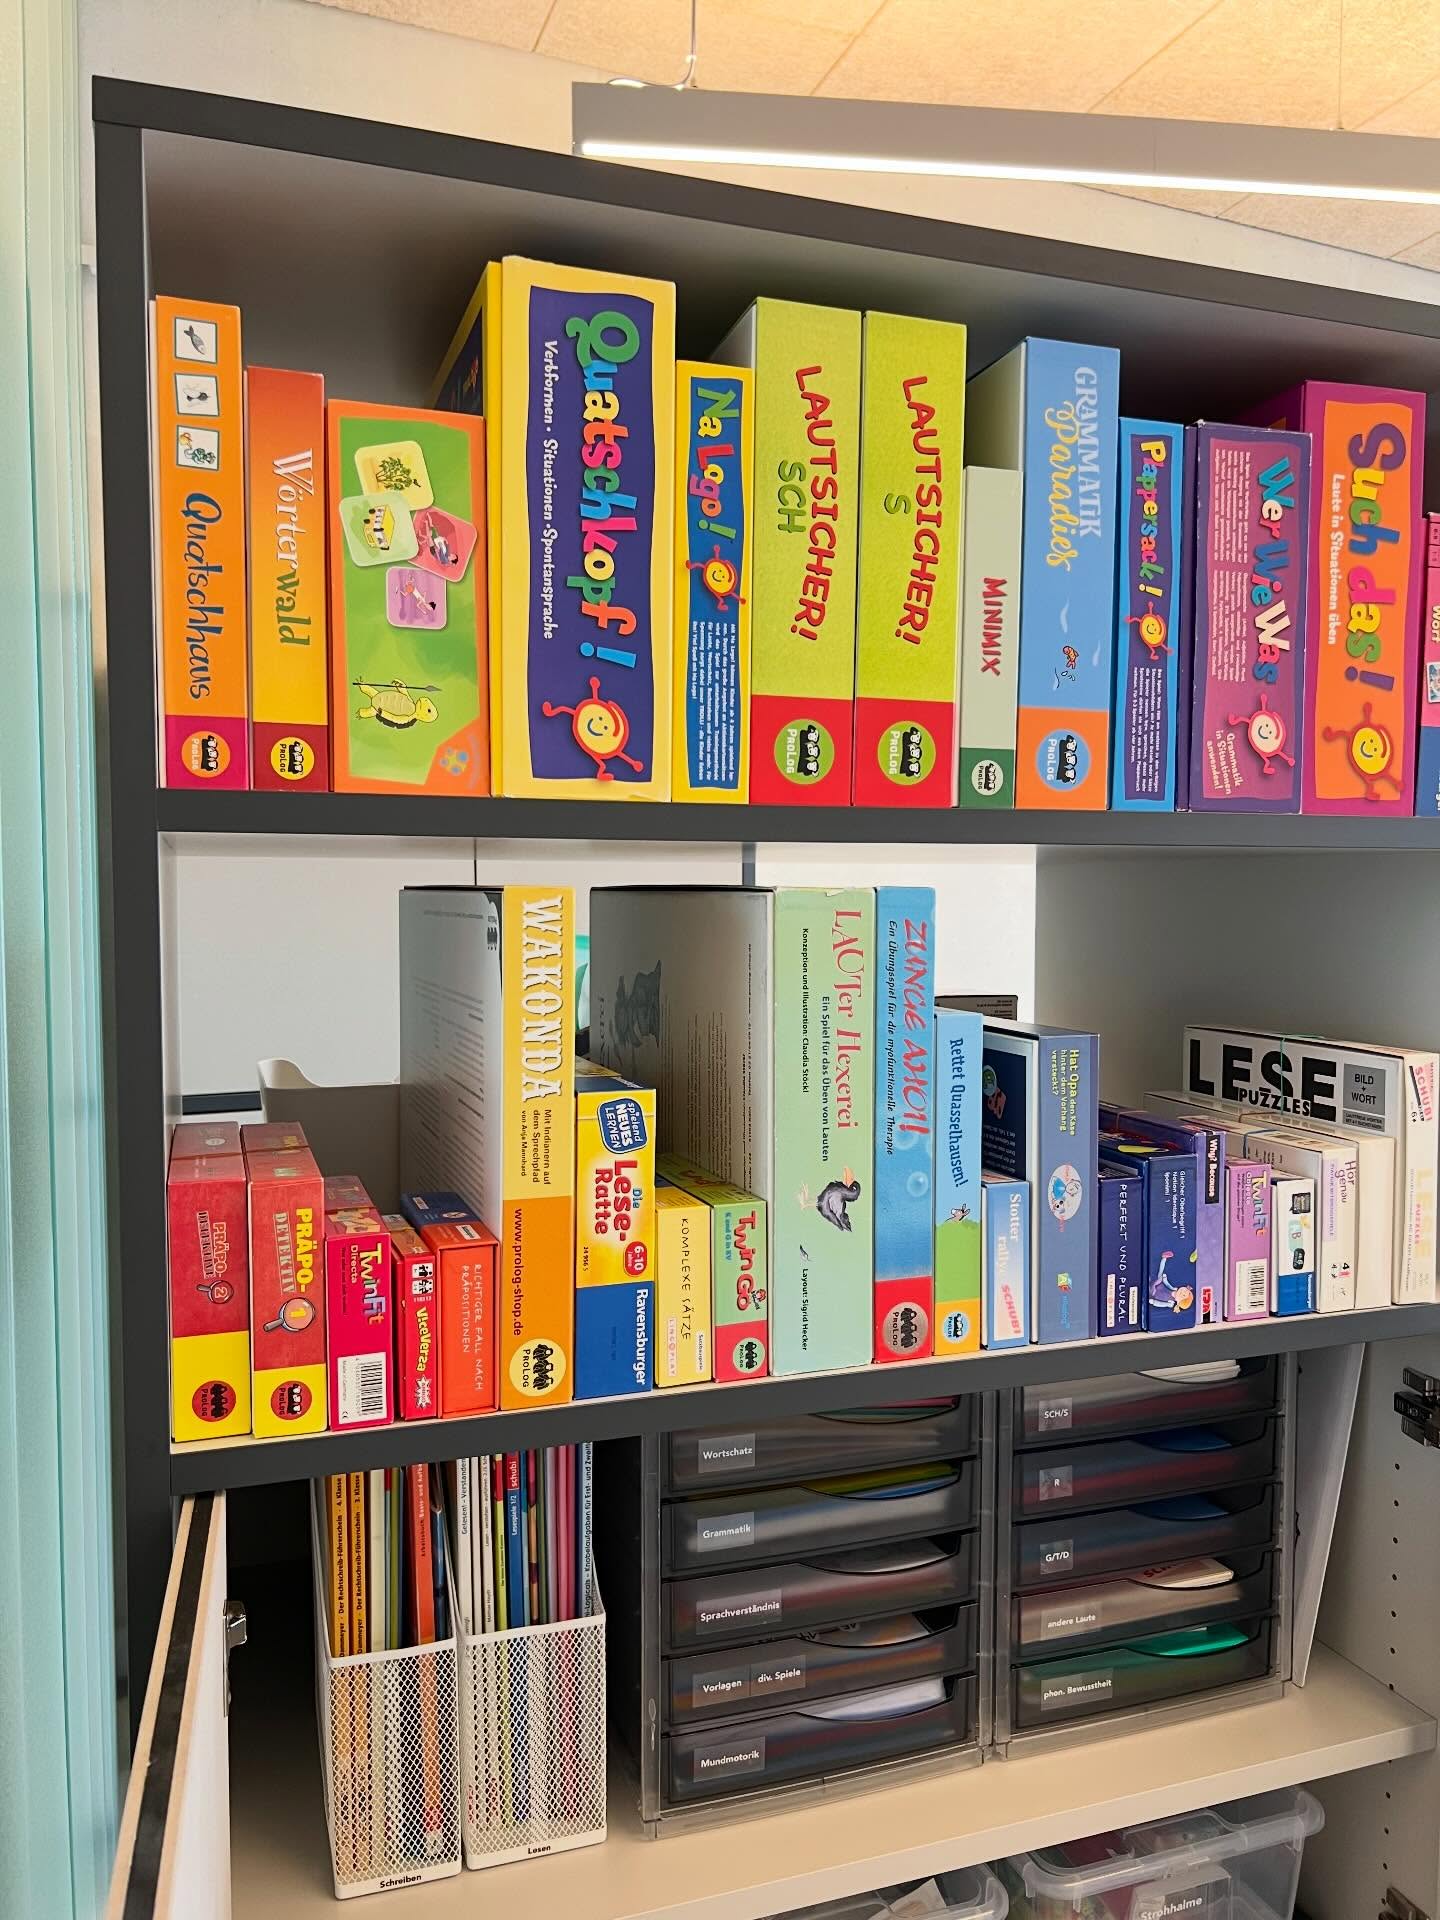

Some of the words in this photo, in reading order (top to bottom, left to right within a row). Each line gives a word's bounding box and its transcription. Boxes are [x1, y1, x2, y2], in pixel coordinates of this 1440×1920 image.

[543, 340, 557, 423] Verbformen
[697, 388, 739, 437] Na
[541, 438, 557, 521] Situationen
[690, 447, 737, 538] Logo!
[778, 460, 807, 533] SCH
[1044, 402, 1081, 572] Paradies
[1331, 474, 1346, 512] Laute
[1347, 423, 1407, 556] Such
[790, 366, 839, 640] LAUTSICHER!
[885, 494, 911, 514] S
[895, 376, 943, 645] LAUTSICHER!
[1330, 515, 1343, 528] in
[272, 449, 314, 645] Wörterwald
[540, 528, 557, 640] Spontansprache
[1327, 532, 1344, 611] Situationen
[181, 493, 224, 699] Quatschhaus
[1325, 614, 1342, 645] üben
[1345, 567, 1397, 692] das!
[1216, 730, 1224, 739] in
[1206, 740, 1223, 790] anwenden!
[1217, 740, 1232, 795] Situationen
[1227, 733, 1244, 787] Grammatik
[889, 921, 897, 938] Ein
[800, 928, 810, 974] Konzeption
[886, 940, 899, 999] Übungsspiel
[801, 976, 809, 990] und
[903, 918, 928, 1032] ZUNGE
[520, 896, 564, 1104] WAKONDA
[801, 991, 810, 1037] Illustration:
[822, 996, 831, 1011] Ein
[885, 1002, 896, 1017] für
[819, 1014, 831, 1038] Spiel
[887, 1021, 896, 1035] die
[801, 1038, 810, 1067] Claudia
[822, 1041, 831, 1054] für
[822, 1057, 830, 1075] das
[949, 1038, 966, 1080] Rettet
[1061, 1049, 1069, 1075] hinter
[1070, 1048, 1080, 1070] Hat
[821, 1077, 832, 1102] Üben
[834, 1028, 862, 1129] Hexerei
[885, 1038, 896, 1112] myofunktionelle
[900, 1039, 930, 1135] AHOI!
[1051, 1049, 1059, 1095] versteckt?
[1067, 1073, 1080, 1097] Opa
[1190, 1039, 1337, 1122] LESE
[1354, 1073, 1374, 1085] BILD
[1059, 1096, 1068, 1130] Vorhang
[1239, 1088, 1311, 1117] PUZZLES
[1351, 1092, 1377, 1105] WORT
[1415, 1066, 1433, 1121] SCHUBI
[532, 1111, 541, 1130] dem
[543, 1110, 552, 1124] Mit
[603, 1107, 620, 1149] LERNEN
[616, 1104, 632, 1148] NEUES
[625, 1103, 643, 1142] spielend
[884, 1116, 896, 1156] Therapie
[949, 1084, 968, 1189] Quasselhausen!
[530, 1132, 541, 1183] Sprechpfad
[543, 1127, 552, 1169] Indianern
[821, 1127, 830, 1162] Lauten
[1207, 1139, 1218, 1160] Why?
[543, 1171, 551, 1185] auf
[1209, 1163, 1217, 1197] Because
[1335, 1170, 1348, 1203] genau
[595, 1168, 613, 1235] Ratte
[613, 1160, 639, 1242] Lese-
[633, 1188, 643, 1209] Die
[1010, 1193, 1022, 1240] Stotter
[1119, 1184, 1127, 1240] PERFEKT
[1251, 1170, 1268, 1237] TwinFit
[213, 1222, 230, 1278] PRÄPO-
[274, 1212, 296, 1294] DETEKTIV
[295, 1208, 317, 1292] PRÄPO-
[634, 1246, 645, 1271] 6-10
[681, 1218, 691, 1291] KOMPLEXE
[733, 1211, 757, 1272] Twin
[351, 1245, 359, 1284] Directa
[359, 1243, 386, 1325] TwinFit
[511, 1208, 525, 1337] www.prolog-shop.de
[800, 1268, 810, 1297] Layout:
[214, 1287, 226, 1298] 2
[461, 1264, 473, 1353] PRÄPOSITIONEN
[474, 1264, 483, 1323] RICHTIGER
[799, 1299, 810, 1322] Sigrid
[1117, 1277, 1127, 1322] PLURAL
[634, 1289, 649, 1386] Ravensburger
[680, 1298, 694, 1340] SÄTZE
[800, 1324, 809, 1351] Hecker
[474, 1327, 483, 1353] FALL
[475, 1359, 483, 1390] NACH
[1044, 1407, 1070, 1420] SCH/S
[703, 1445, 754, 1462] Wortschatz
[510, 1461, 518, 1488] schubi
[1055, 1479, 1061, 1487] R
[703, 1523, 753, 1540] Grammatik
[1045, 1549, 1071, 1563] G/T/D
[700, 1600, 782, 1623] Sprachverständnis
[1047, 1616, 1074, 1628] andere
[1075, 1612, 1098, 1625] Laute
[703, 1678, 743, 1694] Vorlagen
[758, 1670, 774, 1683] div.
[775, 1667, 803, 1683] Spiele
[1044, 1686, 1065, 1700] phon.
[1067, 1678, 1113, 1697] Bewusstheit
[701, 1748, 761, 1768] Mundmotorik
[527, 1843, 552, 1856] Lesen
[380, 1874, 422, 1888] Schreiben
[1140, 1897, 1203, 1920] Strohhalme
